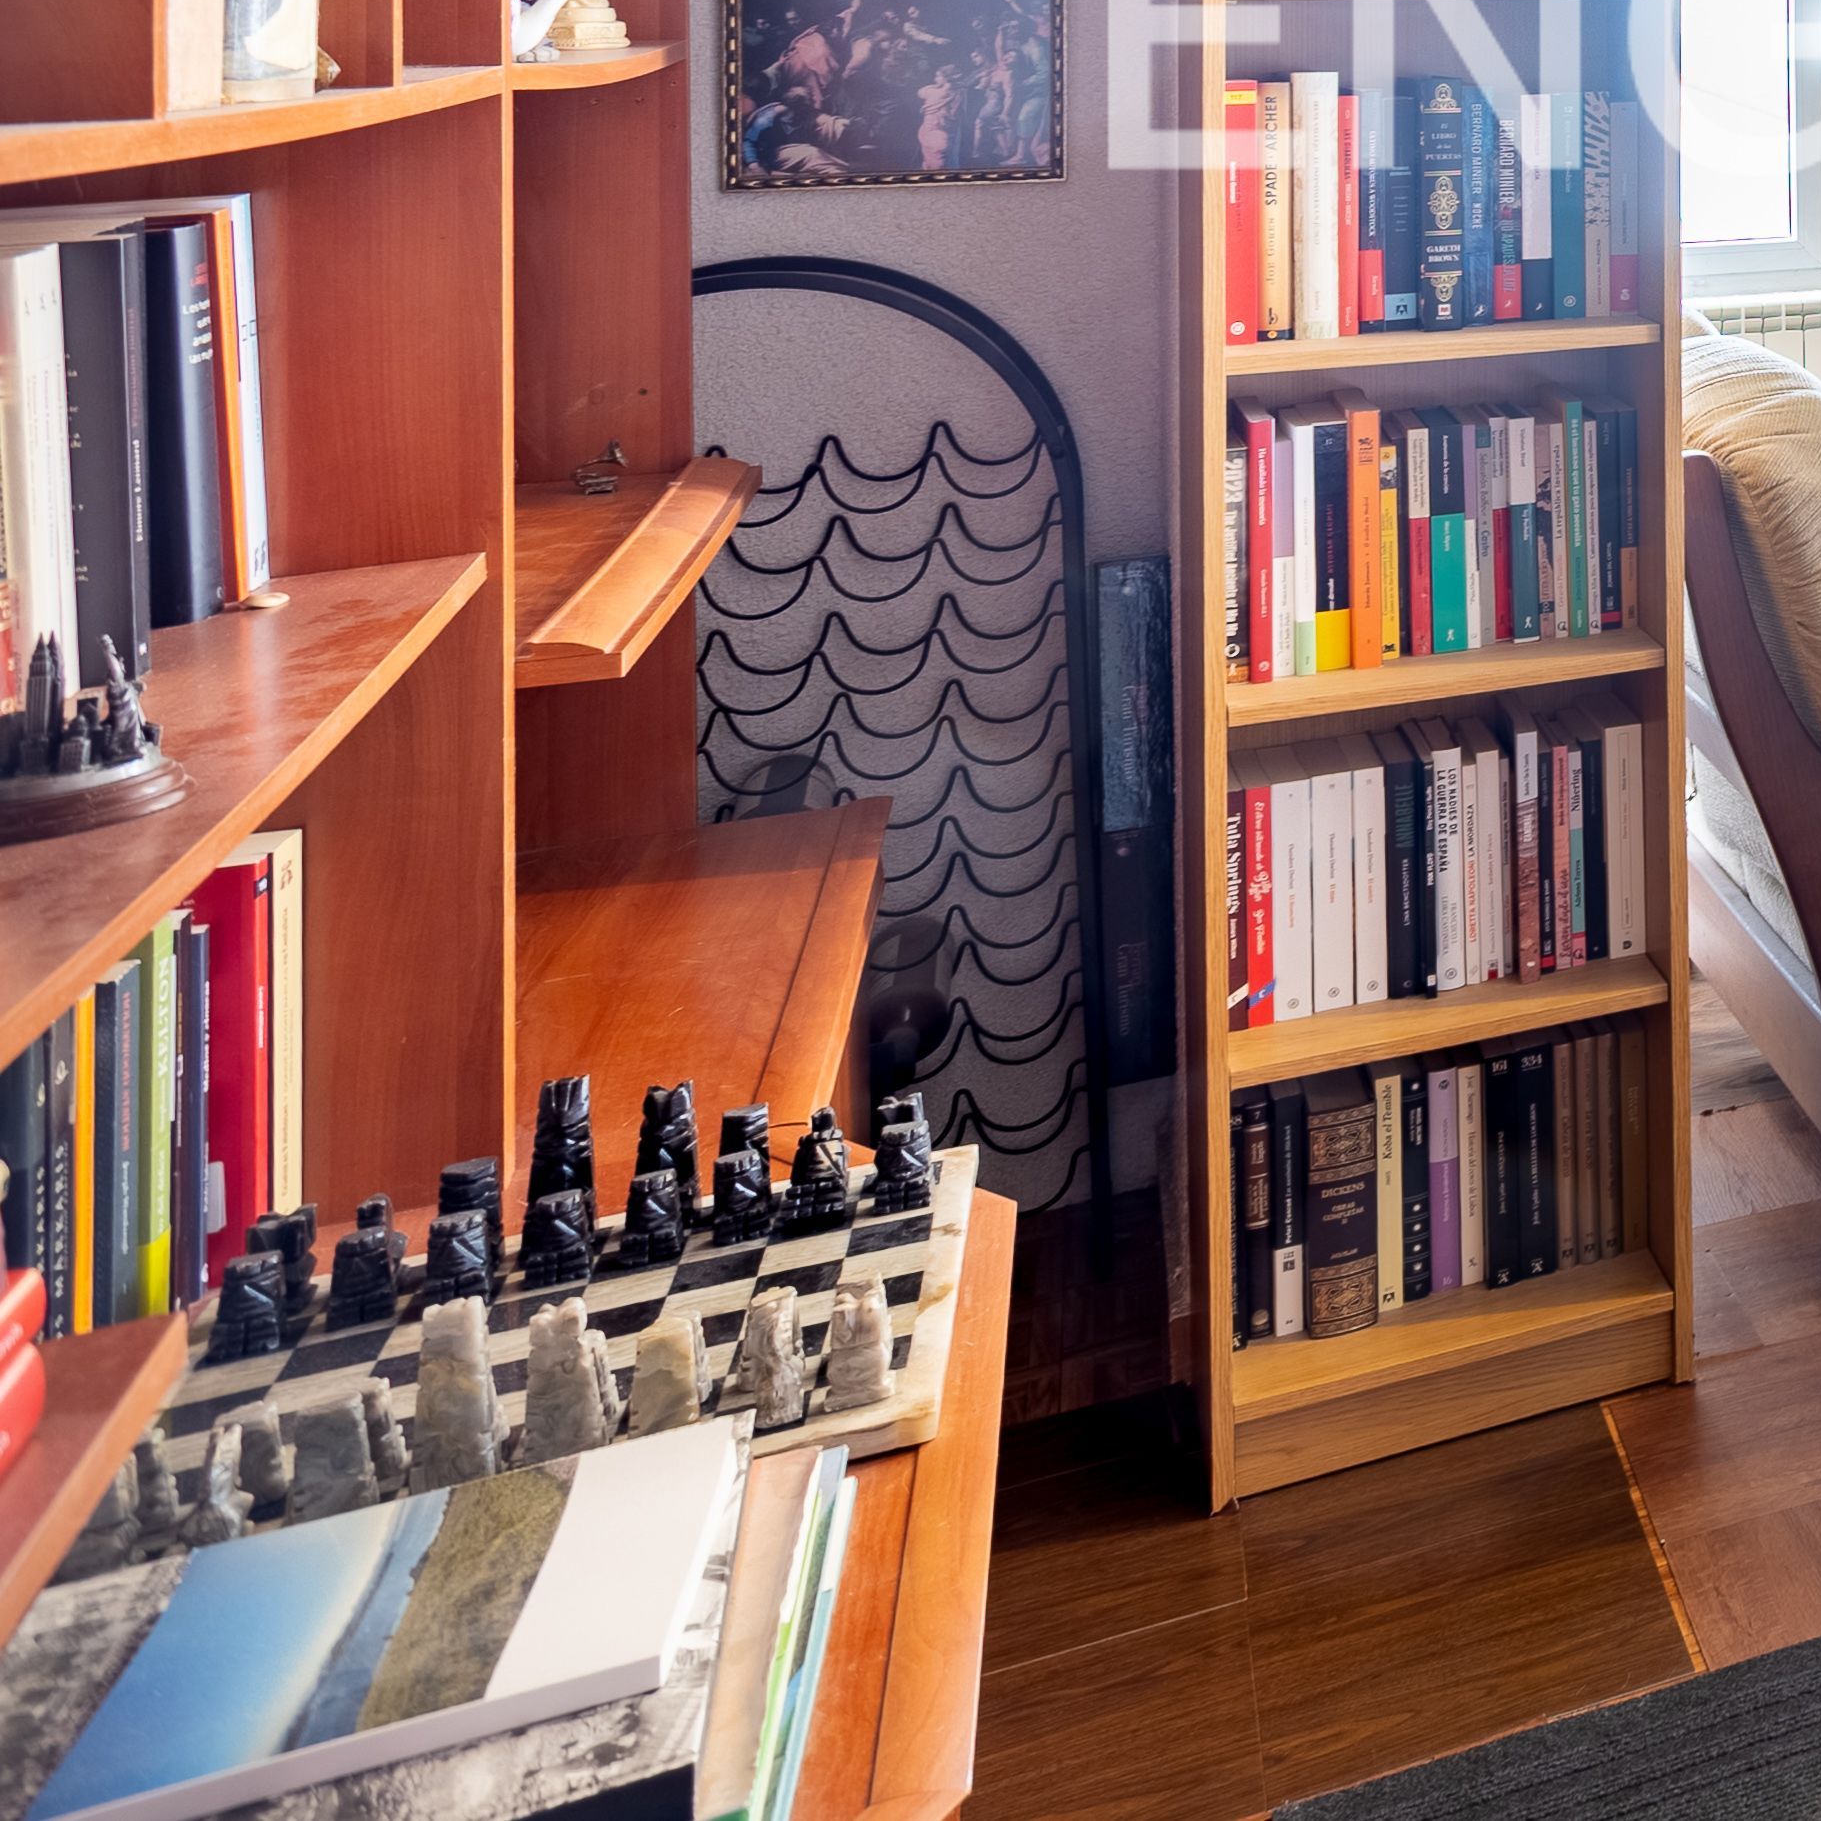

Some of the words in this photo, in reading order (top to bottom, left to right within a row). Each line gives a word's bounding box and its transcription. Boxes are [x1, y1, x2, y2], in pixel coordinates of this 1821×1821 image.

[1265, 96, 1277, 150] ARCHER
[1471, 104, 1482, 153] BERNARD
[1499, 120, 1514, 166] BERNARD
[1265, 164, 1277, 205] SPADE
[1471, 157, 1481, 194] MINIER
[1499, 169, 1514, 203] MINIER
[1471, 203, 1482, 230] NOCHE
[1426, 244, 1461, 253] GARETH
[1226, 458, 1243, 503] 2023
[1479, 453, 1488, 488] Sebastián
[1480, 489, 1489, 519] Balfour
[1480, 530, 1490, 557] Castro
[1436, 770, 1446, 781] LA
[1447, 768, 1457, 785] LOS
[1570, 769, 1583, 812] Niñering
[1395, 784, 1414, 848] ANNABELLE
[1436, 784, 1447, 822] GUERRA
[1448, 789, 1458, 821] NADIES
[1437, 824, 1448, 835] DE
[1448, 823, 1458, 835] DE
[1466, 803, 1475, 844] MORDAZA
[1437, 838, 1450, 873] ESPAÑA
[1468, 846, 1475, 857] LA
[1467, 860, 1476, 905] NAPOLEONI
[1468, 908, 1476, 942] LORETTA
[157, 957, 170, 1078] KELTON
[1520, 1051, 1544, 1069] 334
[1381, 1084, 1393, 1121] Temible
[1381, 1123, 1393, 1133] el
[1381, 1135, 1394, 1159] Koba
[1321, 1181, 1366, 1201] DICKENS
